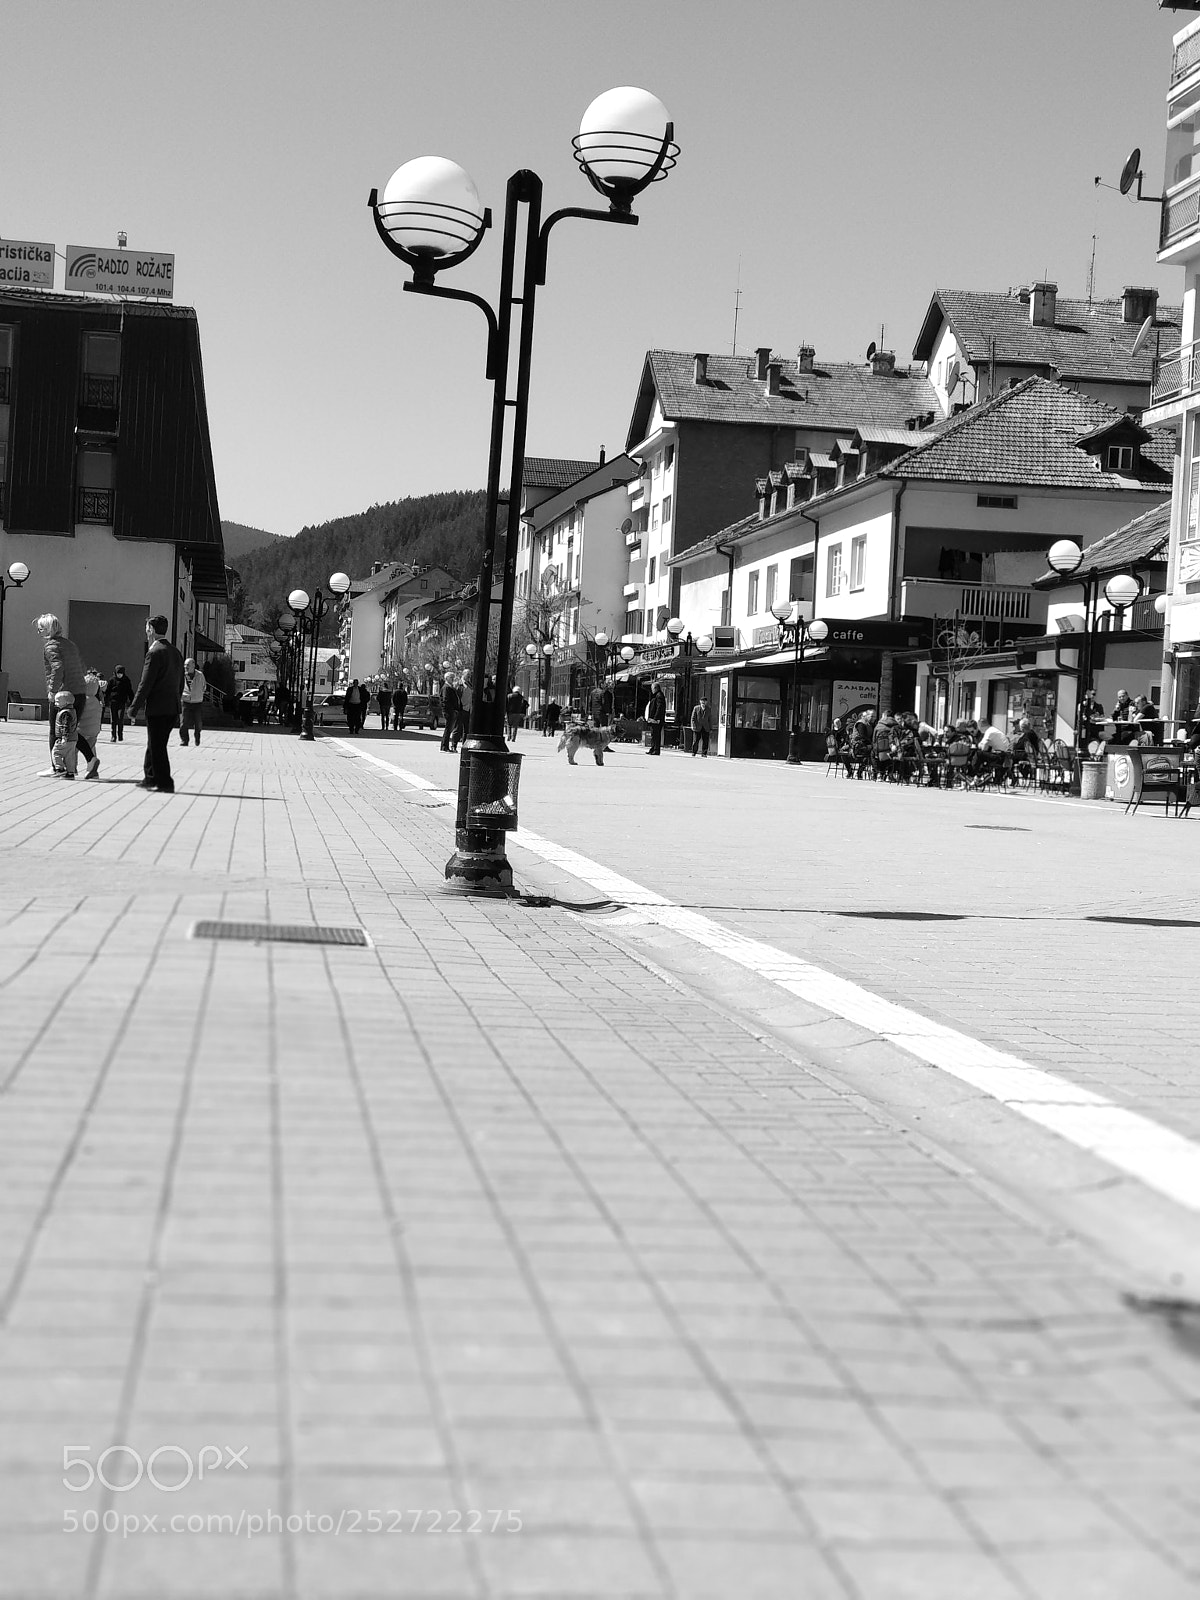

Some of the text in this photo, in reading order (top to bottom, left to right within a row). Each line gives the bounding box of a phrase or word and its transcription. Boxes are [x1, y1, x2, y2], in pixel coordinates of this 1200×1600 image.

[97, 257, 129, 275] RADIO
[136, 256, 172, 279] ROŽAJE
[95, 283, 171, 296] 101.4 104.4 107.4 Mhz
[833, 630, 864, 640] caffe
